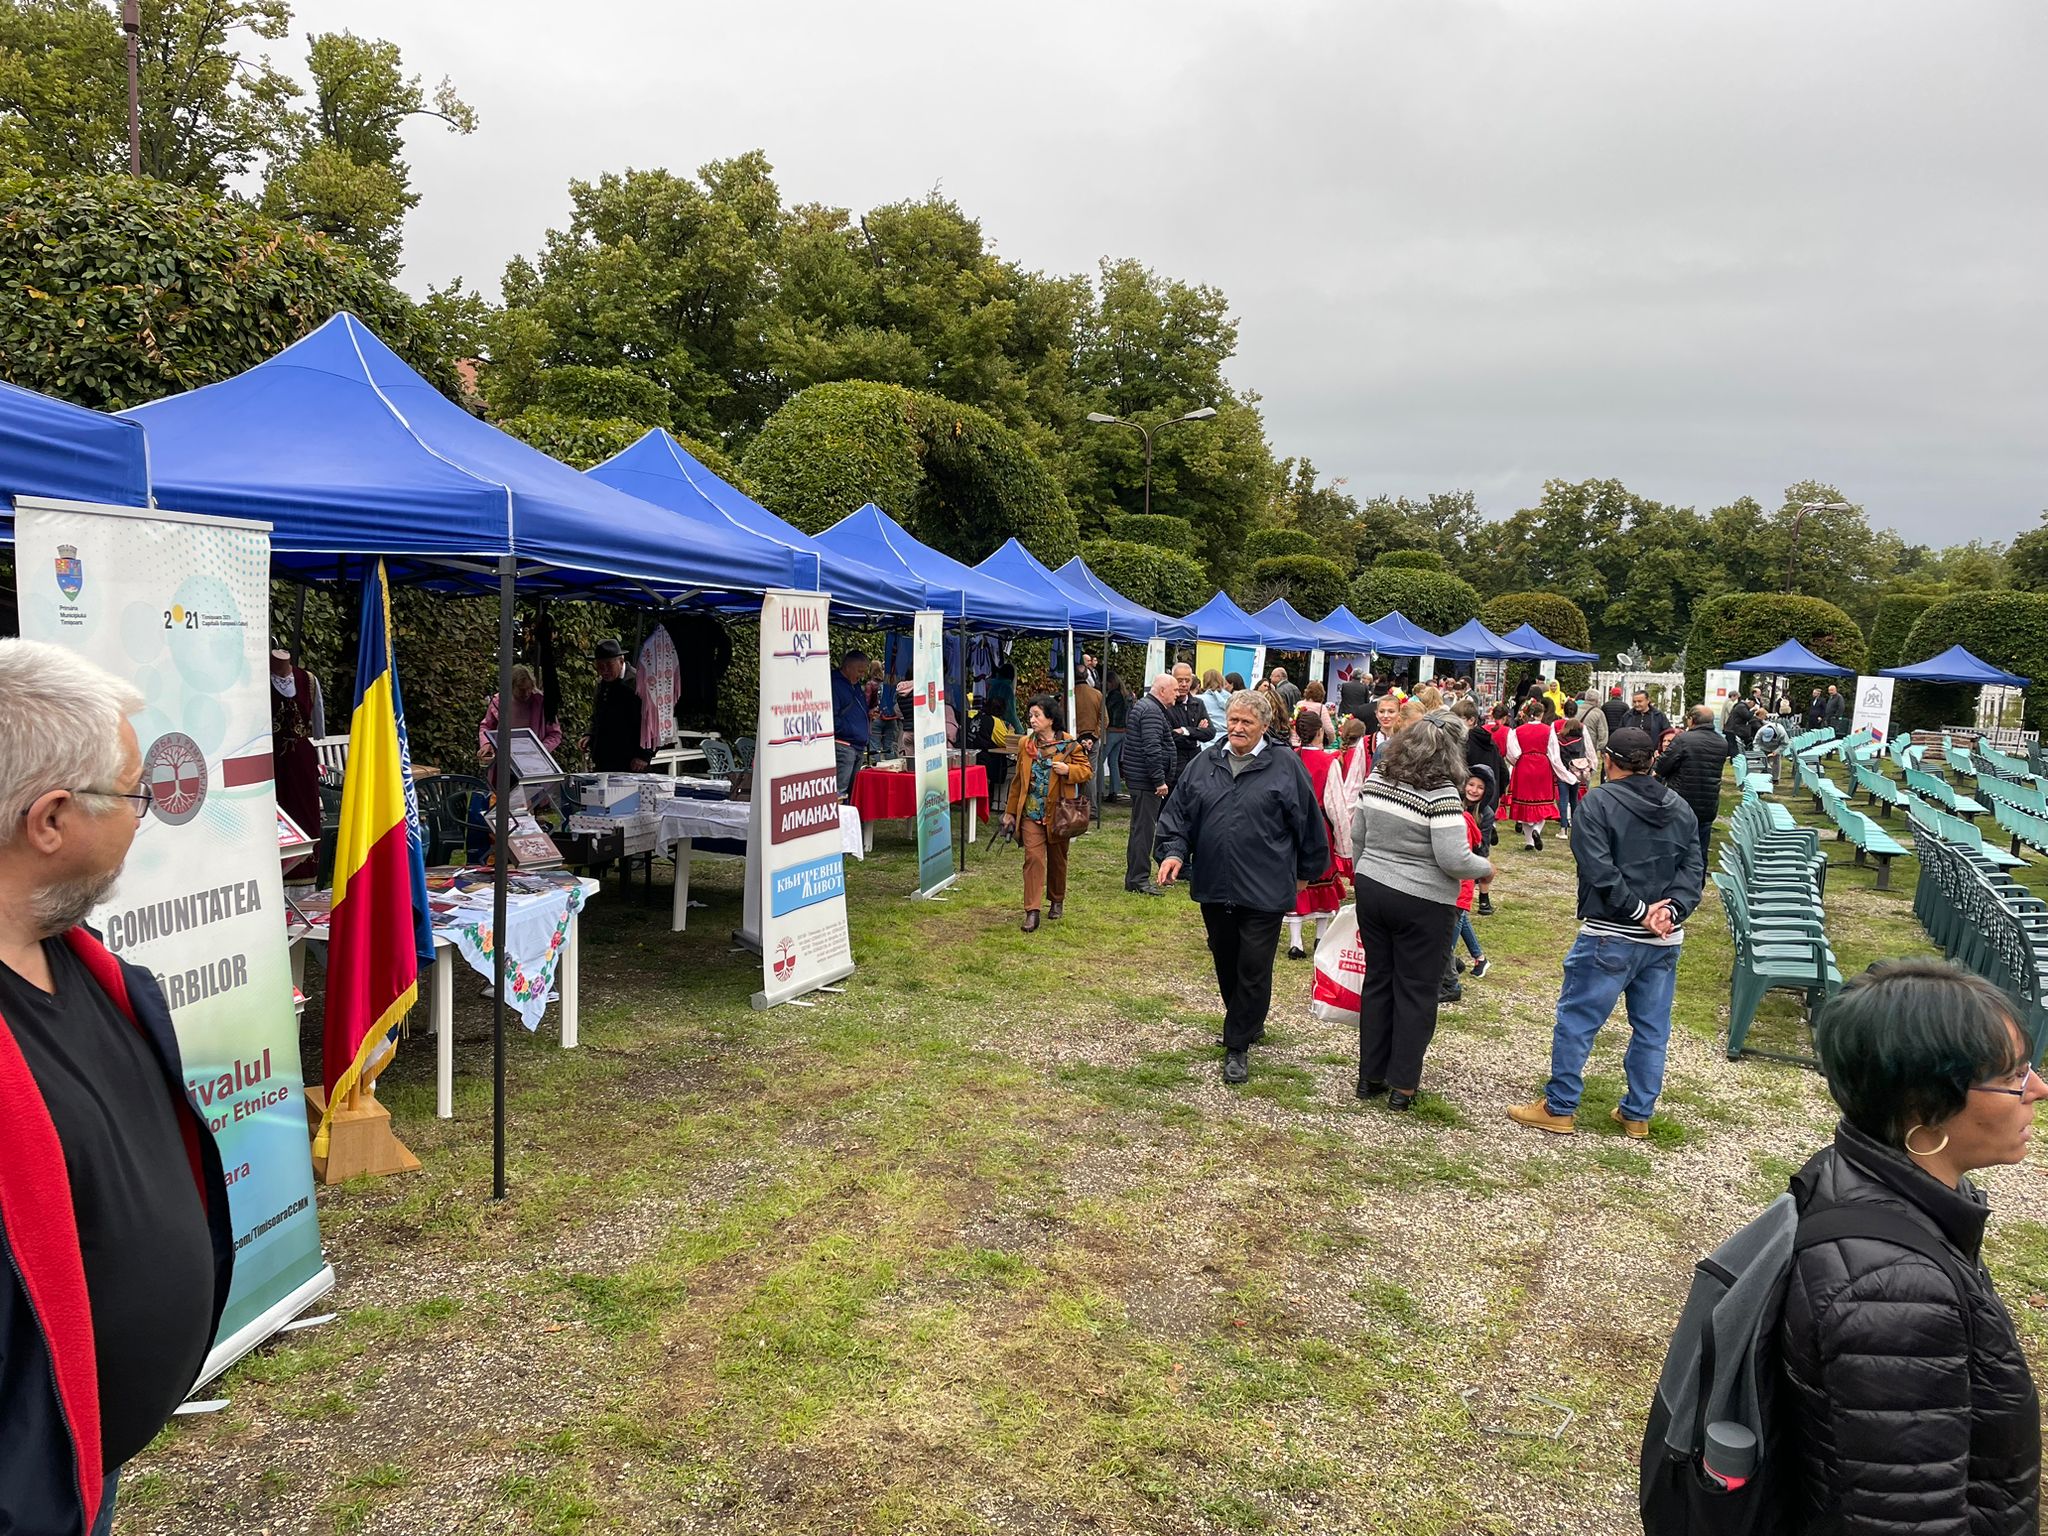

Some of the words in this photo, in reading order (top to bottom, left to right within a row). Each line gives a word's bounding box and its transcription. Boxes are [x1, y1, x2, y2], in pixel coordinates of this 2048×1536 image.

[781, 607, 820, 632] НАША
[780, 775, 838, 805] БАНАТСКИ
[781, 802, 838, 833] АЛМАНАХ
[107, 879, 262, 953] COMUNITATEA
[233, 1086, 289, 1123] Etnice
